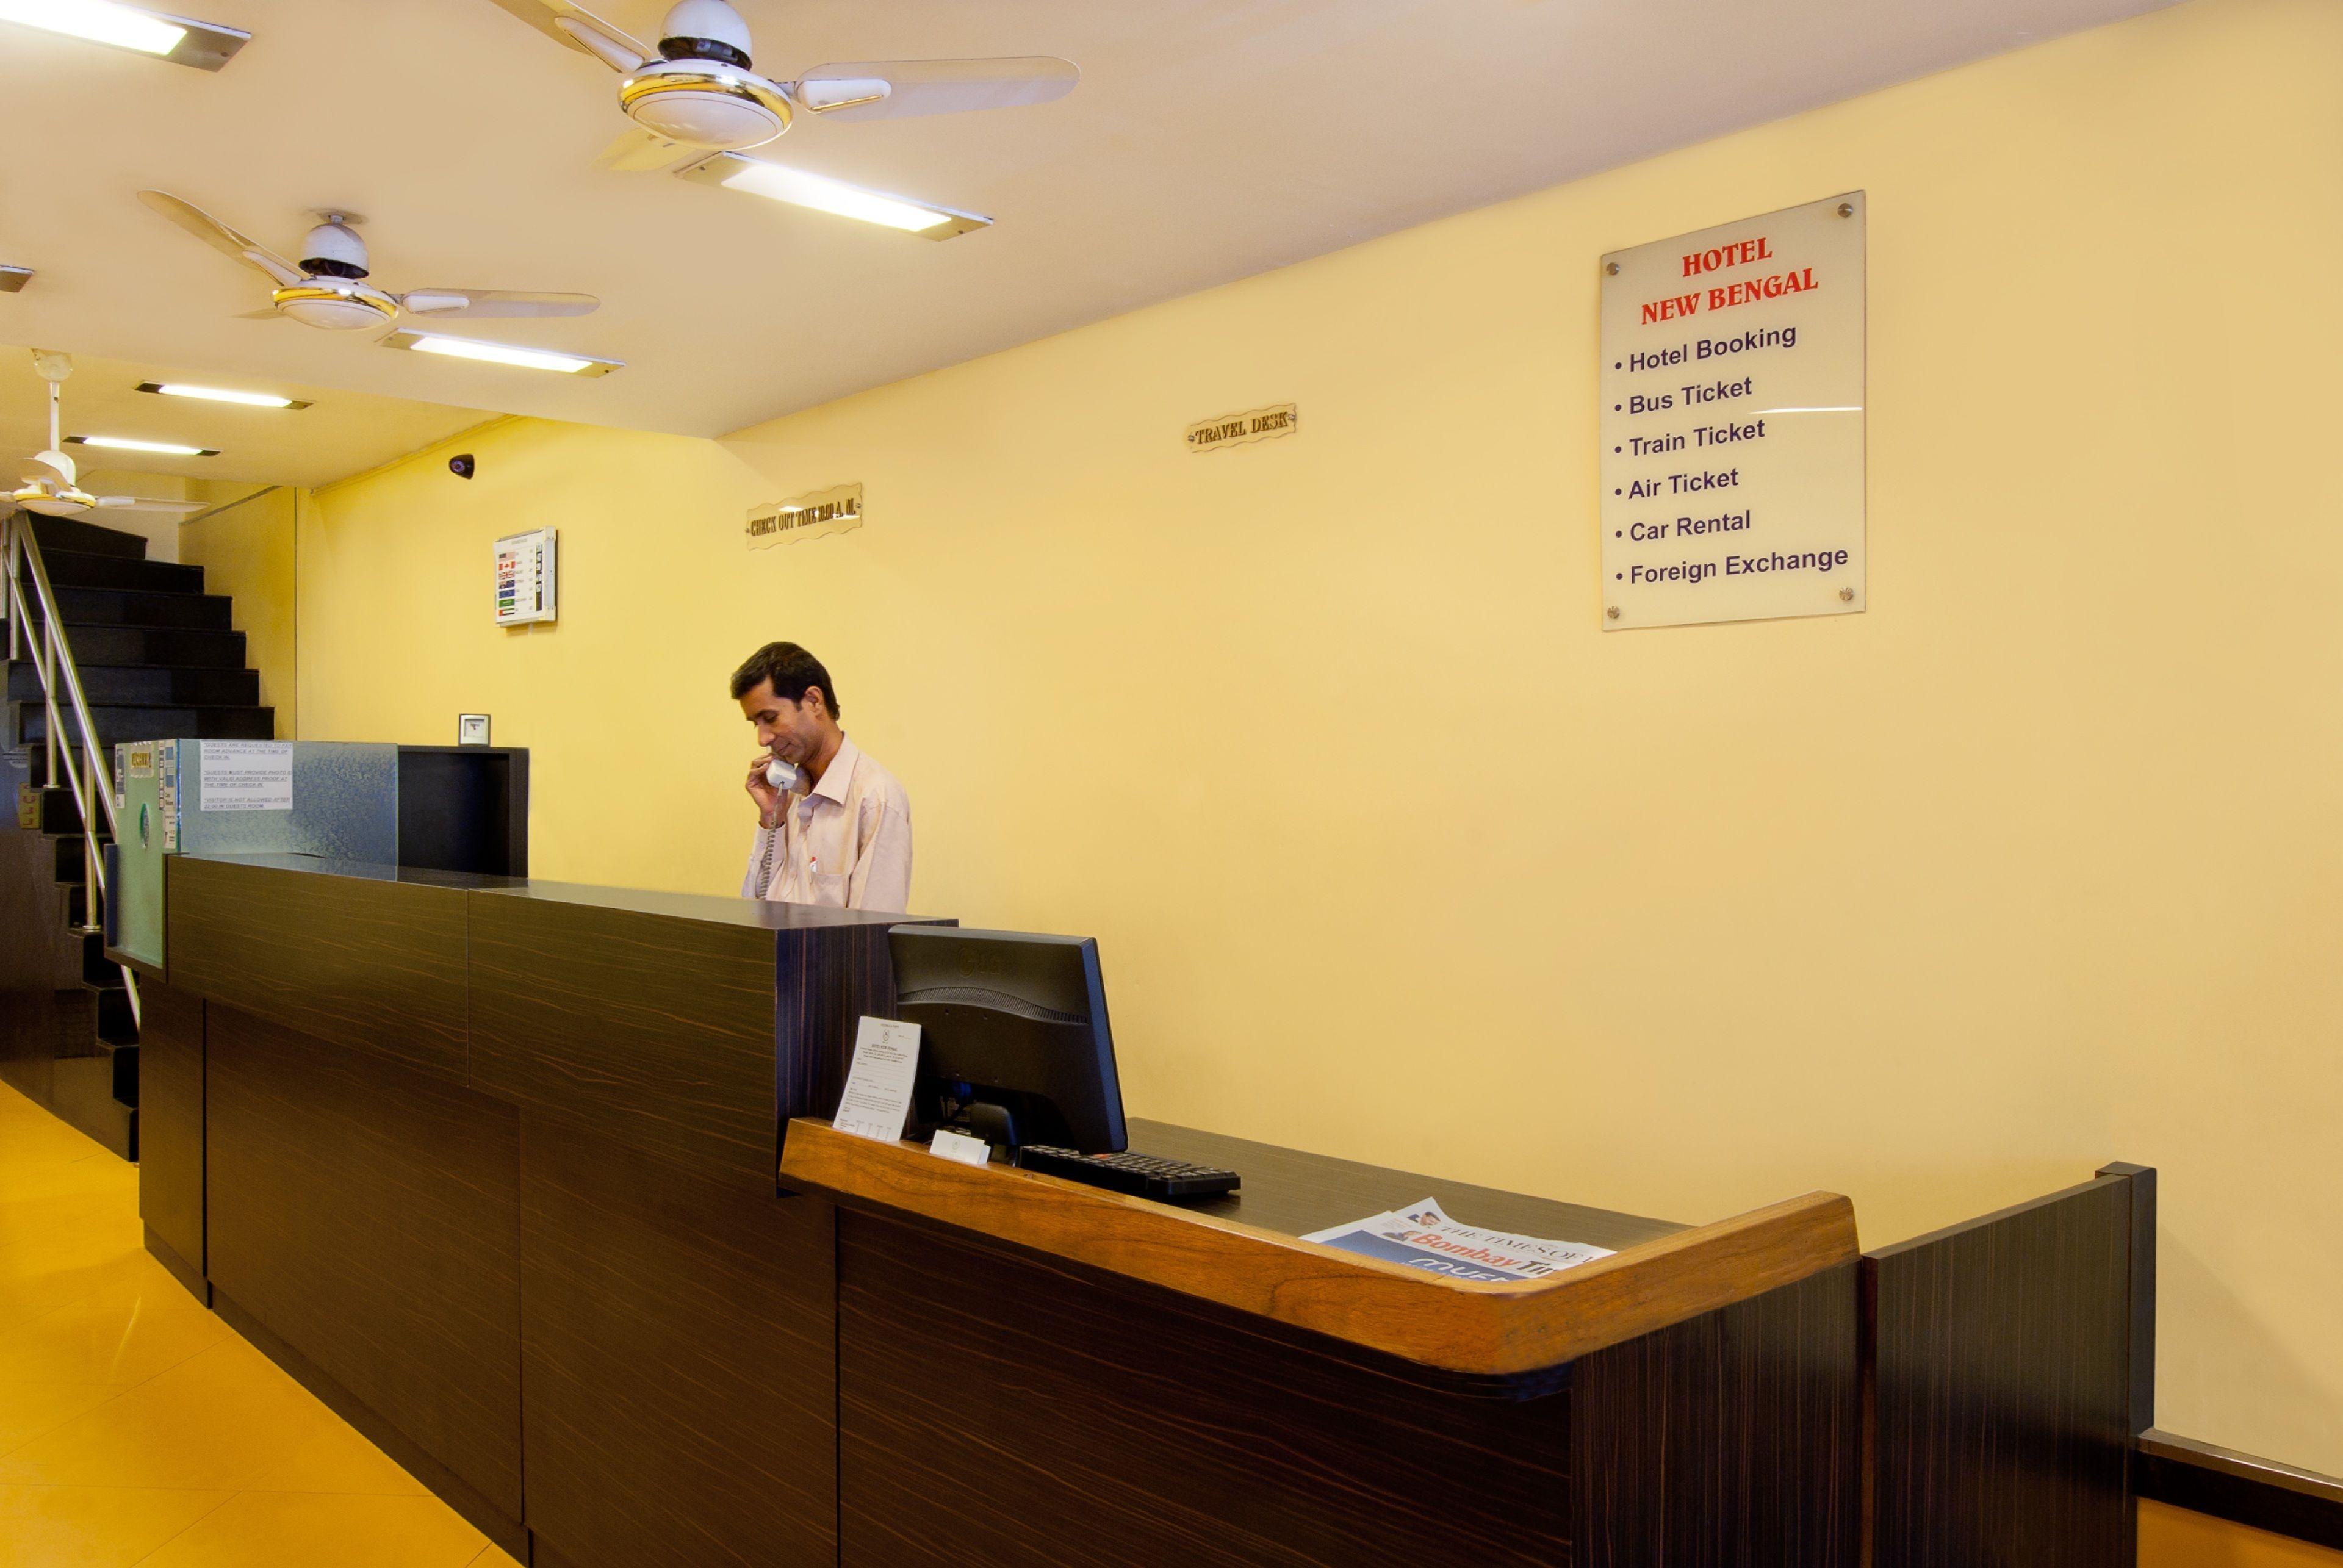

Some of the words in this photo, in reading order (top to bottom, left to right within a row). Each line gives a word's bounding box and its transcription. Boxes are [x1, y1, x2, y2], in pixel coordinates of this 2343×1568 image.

[1682, 237, 1773, 277] HOTEL
[1641, 292, 1701, 325] NEW
[1708, 267, 1819, 311] BENGAL
[1630, 344, 1688, 372] Hotel
[1696, 326, 1796, 359] Booking
[1630, 394, 1673, 414] Bus
[1681, 376, 1752, 405] Ticket
[1195, 421, 1247, 444] TRAVEL
[1250, 411, 1288, 433] DESK
[1629, 433, 1685, 456] Train
[1693, 419, 1765, 447] Ticket
[1628, 479, 1661, 500] Air
[1668, 468, 1739, 494] Ticket
[751, 516, 777, 537] CHECK
[779, 511, 794, 530] OUT
[1630, 522, 1669, 542] Car
[1677, 510, 1751, 536] Rental
[1631, 560, 1717, 584] Foreign
[1726, 550, 1848, 575] Exchange
[1411, 1233, 1523, 1267] Bombay
[1441, 1226, 1482, 1238] THE
[1485, 1236, 1550, 1253] TIMES
[1550, 1250, 1584, 1259] OF
